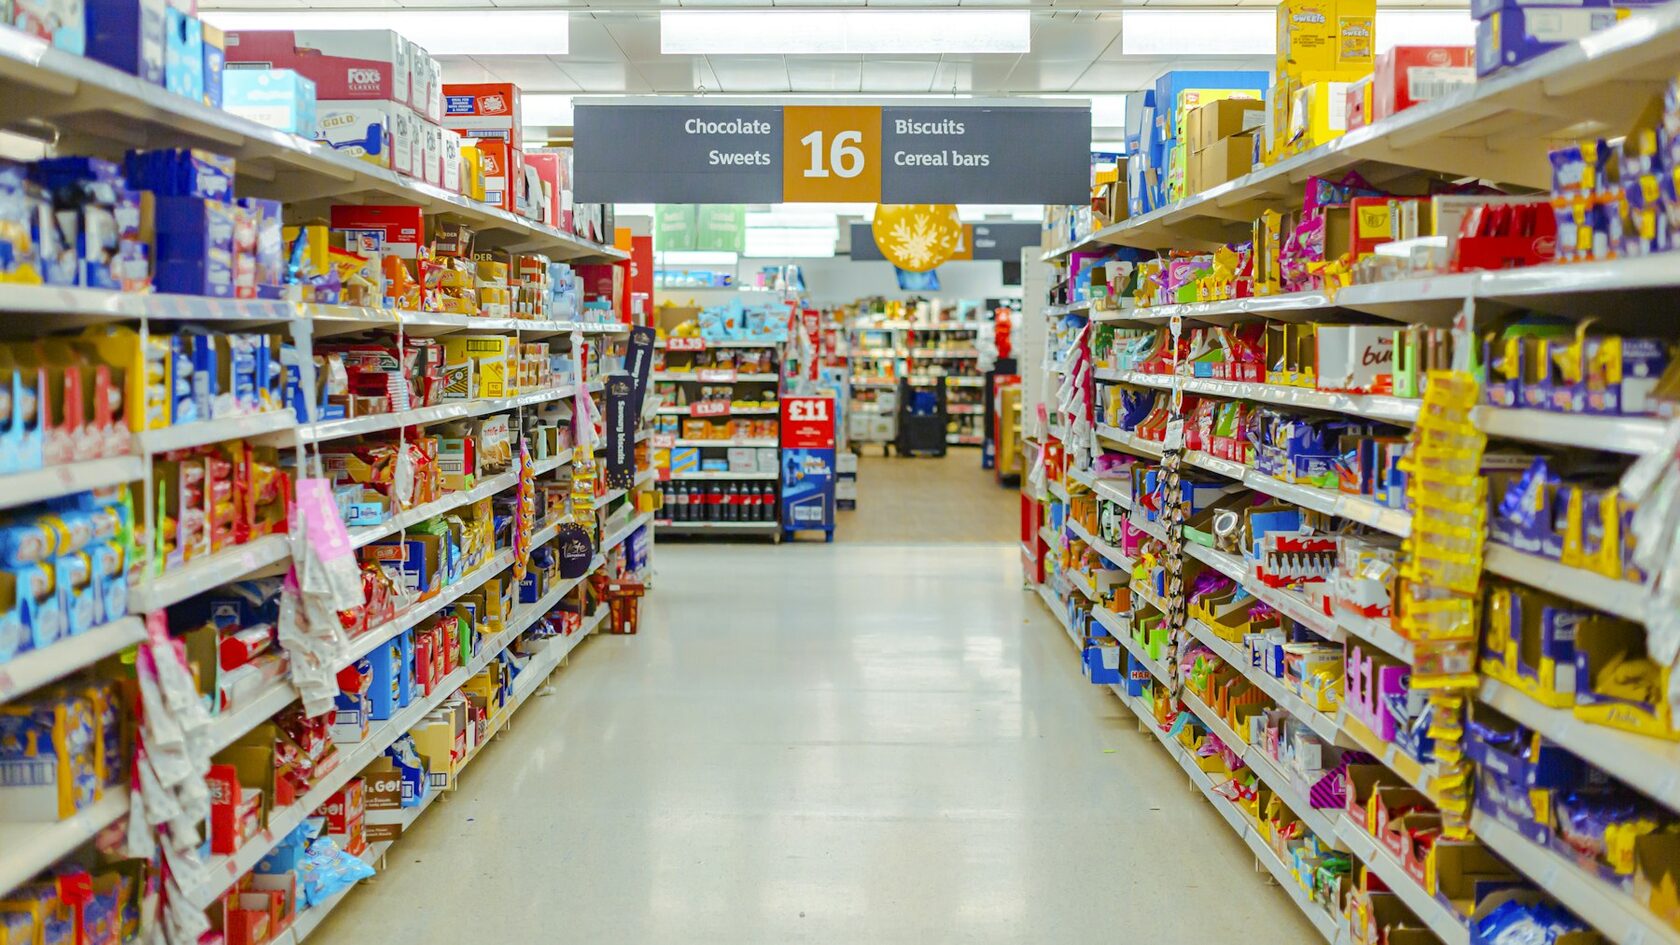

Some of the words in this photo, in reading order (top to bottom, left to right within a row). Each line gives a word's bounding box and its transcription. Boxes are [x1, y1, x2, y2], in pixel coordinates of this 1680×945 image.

[323, 115, 354, 127] GOLD
[685, 119, 771, 134] Chocolate
[895, 119, 965, 134] Biscuits
[709, 150, 771, 165] Sweets
[800, 130, 865, 178] 16
[894, 150, 948, 166] Cereal
[952, 150, 990, 166] bars
[474, 253, 493, 261] DER
[616, 400, 625, 432] Savoury
[788, 400, 828, 421] £11
[617, 433, 625, 465] biscuits
[1131, 671, 1151, 680] HAR
[375, 780, 401, 793] GO!
